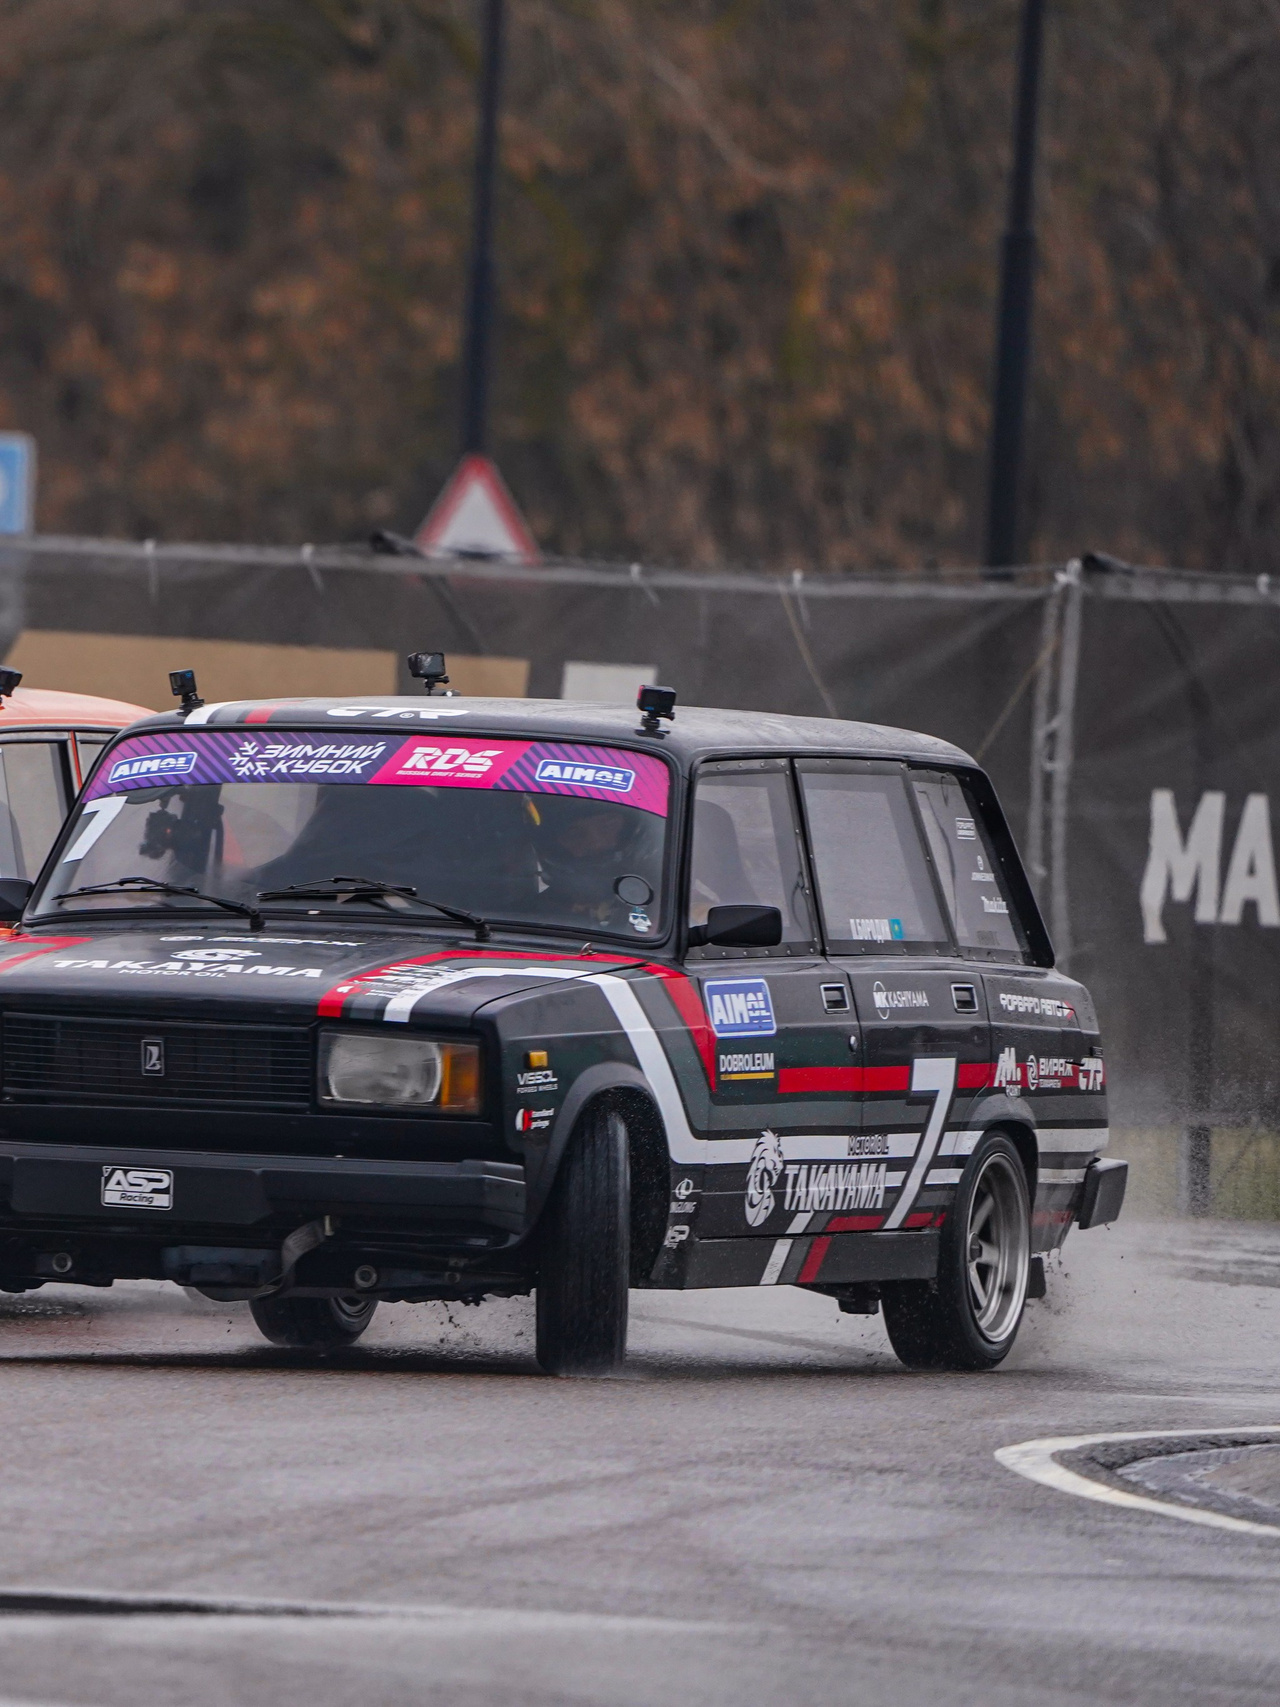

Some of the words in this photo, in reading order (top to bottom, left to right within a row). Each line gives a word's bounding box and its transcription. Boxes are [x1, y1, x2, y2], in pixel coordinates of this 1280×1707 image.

[257, 742, 387, 760] ЗИМНИЙ
[402, 746, 504, 772] RDS
[111, 757, 190, 779] AIMOL
[271, 759, 373, 775] КУБОК
[540, 764, 628, 788] AIMOL
[53, 960, 323, 978] TAKAYAMA
[119, 969, 190, 977] MOTOR
[712, 992, 771, 1025] AIMOL
[719, 1053, 775, 1072] DOBROLEUM
[1039, 1057, 1074, 1076] ВИРАЖ
[848, 1134, 875, 1157] MOTOR
[875, 1133, 890, 1155] OIL
[883, 1058, 957, 1229] 7
[105, 1169, 171, 1193] ASP
[784, 1163, 888, 1211] TAKAYAMA
[120, 1192, 155, 1205] Racing
